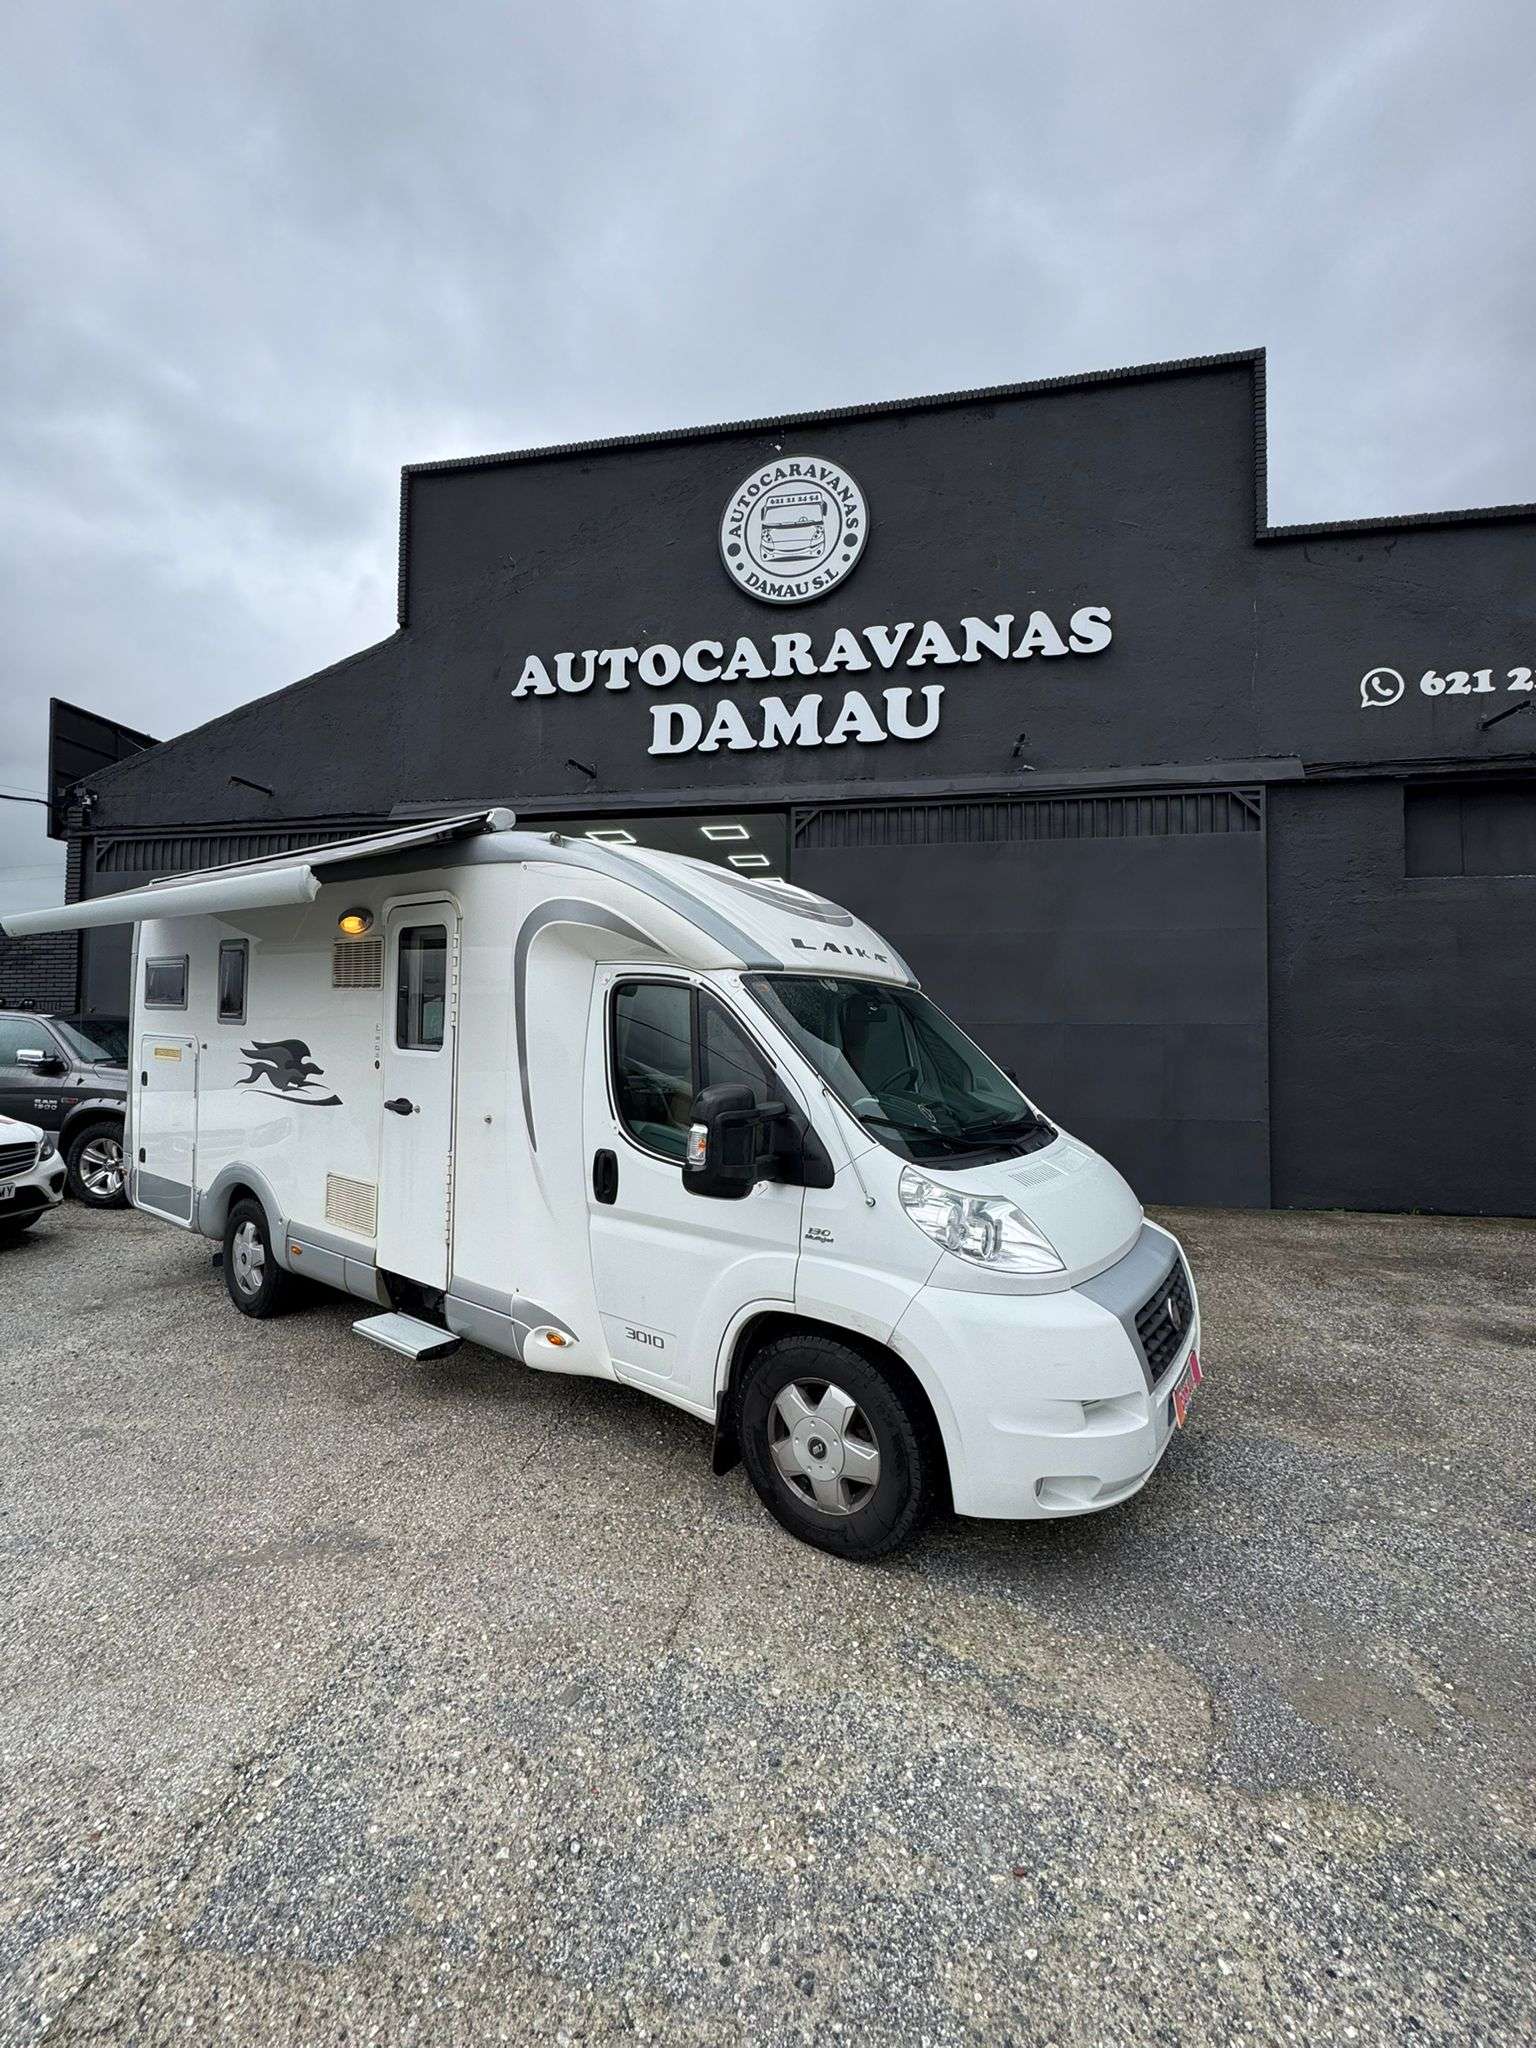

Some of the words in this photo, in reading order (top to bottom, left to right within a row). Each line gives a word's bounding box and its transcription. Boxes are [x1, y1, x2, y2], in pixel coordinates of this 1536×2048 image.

[729, 463, 859, 539] AUTOCARAVANAS
[745, 572, 809, 597] DAMAU
[511, 606, 1113, 697] AUTOCARAVANAS
[1420, 669, 1496, 696] 621
[1507, 667, 1536, 692] 2
[648, 685, 945, 754] DAMAU
[791, 938, 888, 963] LAIKA
[625, 1327, 665, 1349] 3010
